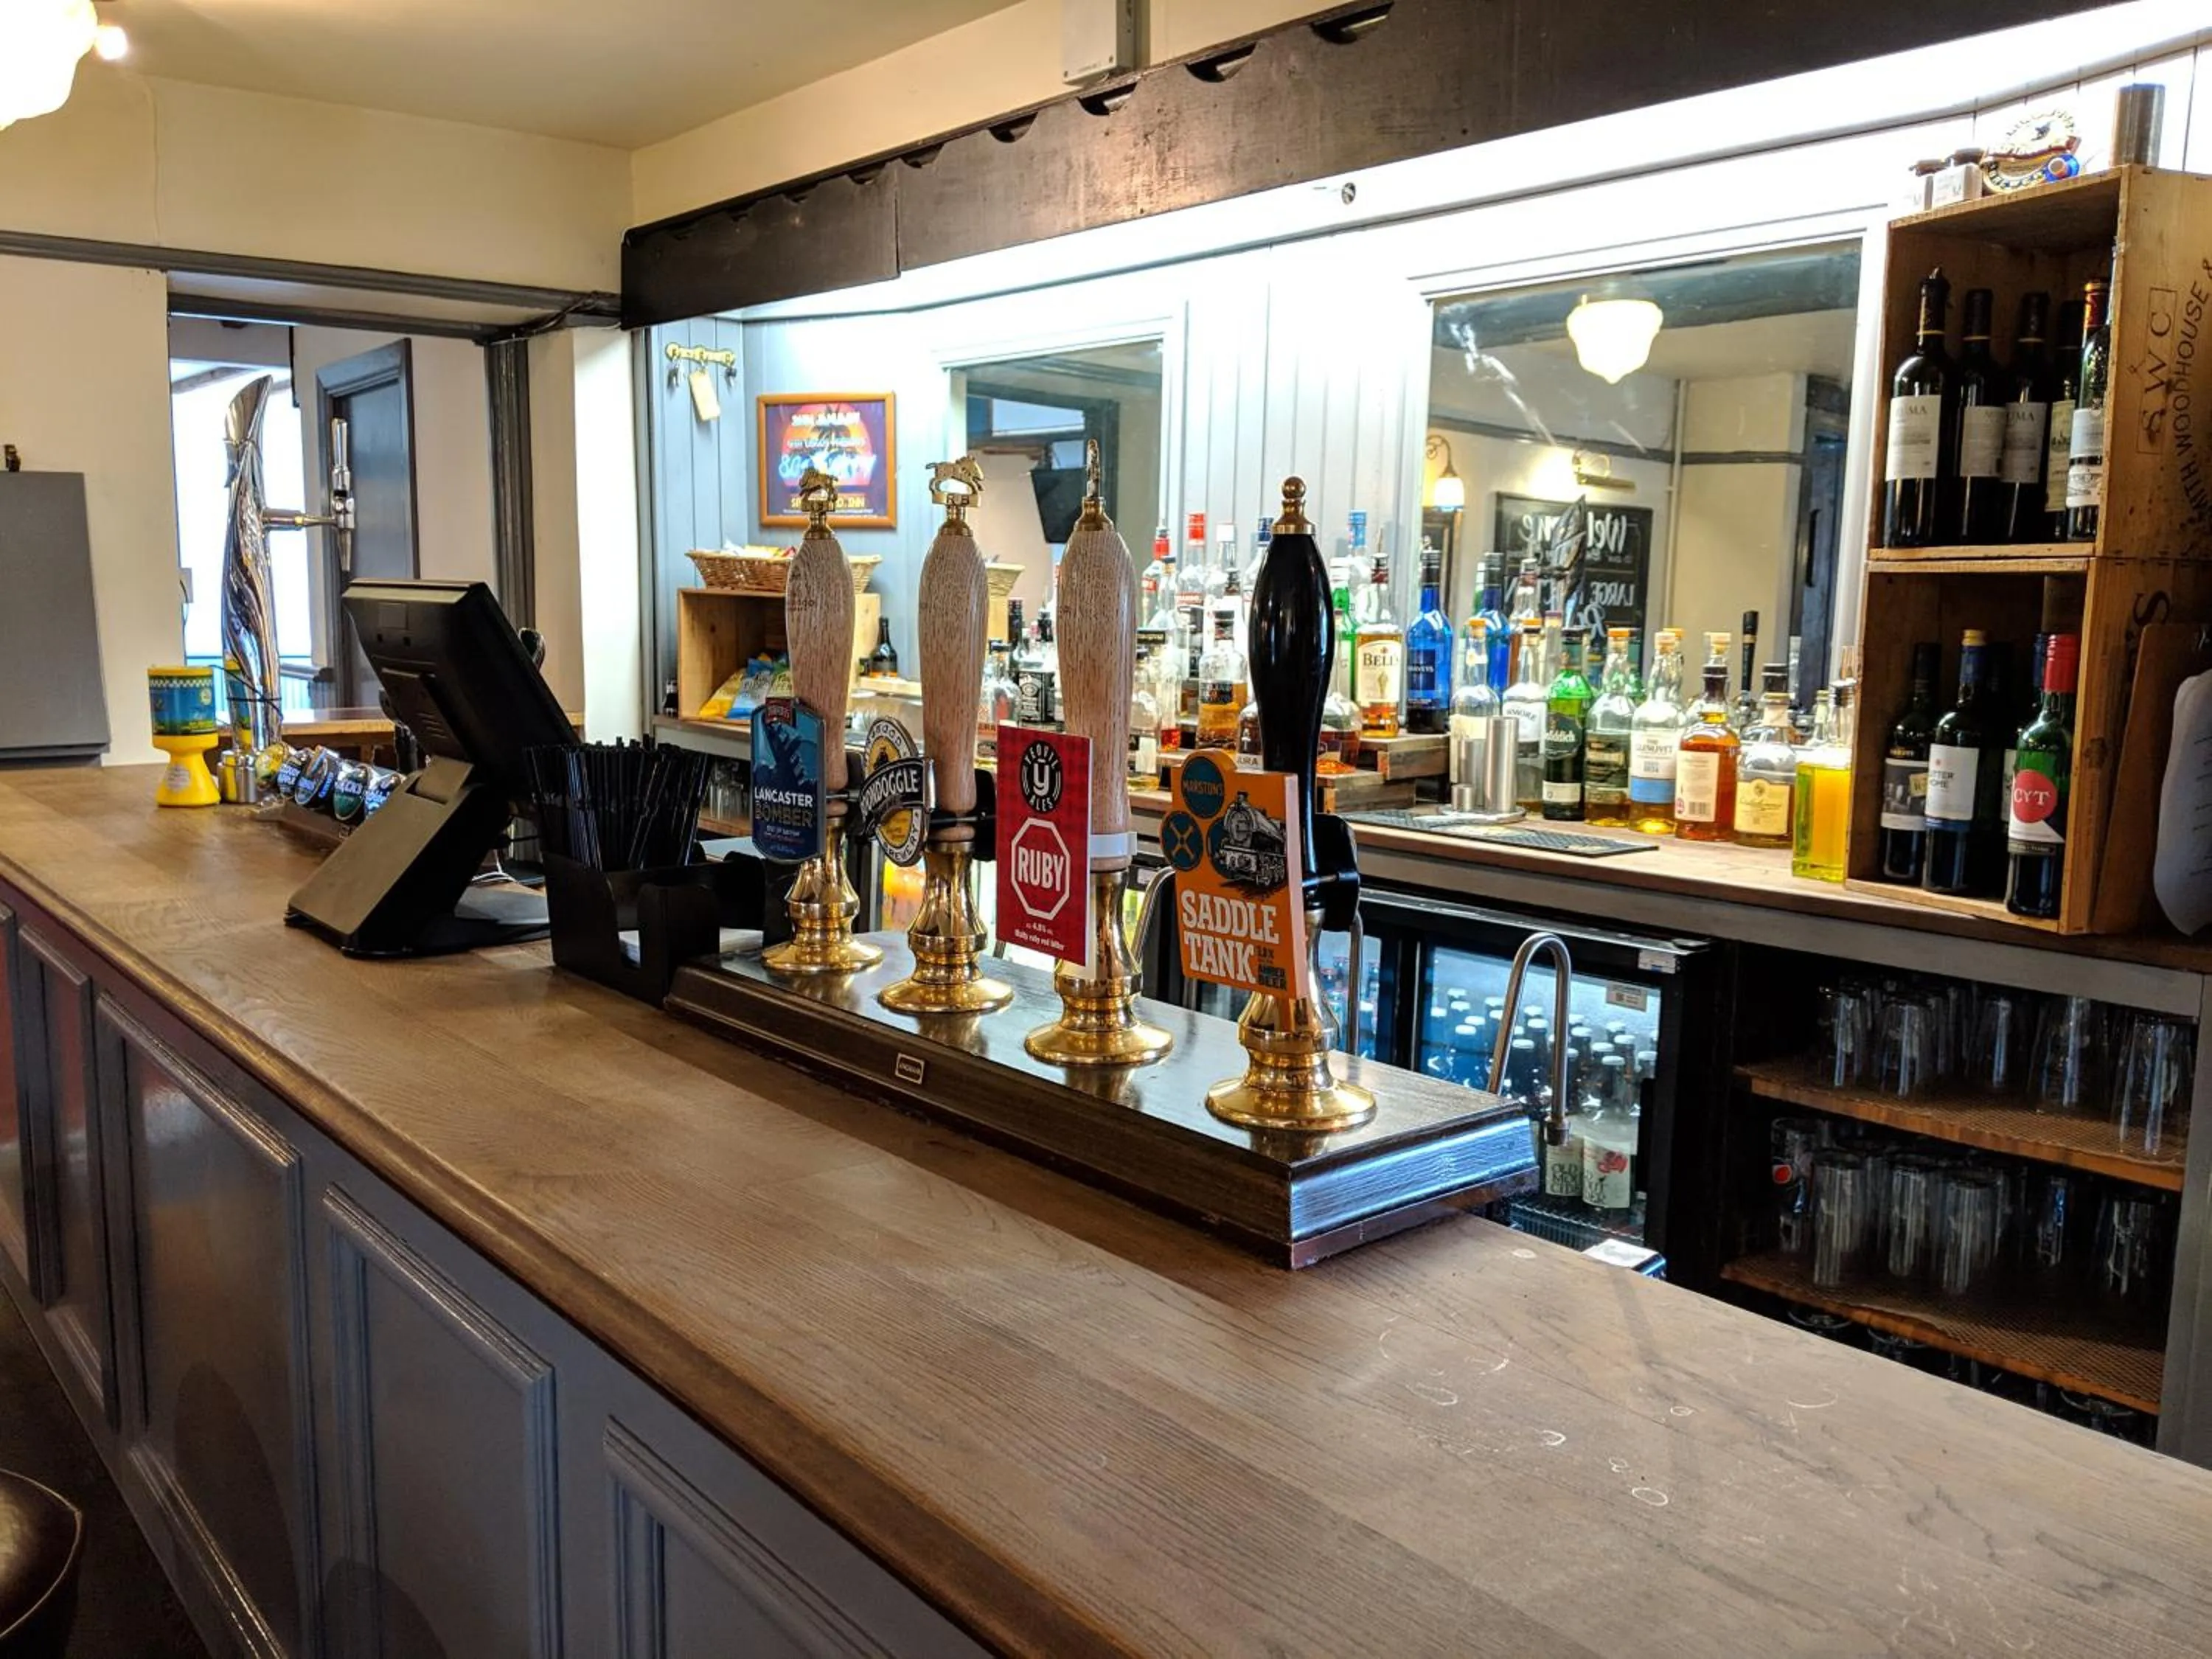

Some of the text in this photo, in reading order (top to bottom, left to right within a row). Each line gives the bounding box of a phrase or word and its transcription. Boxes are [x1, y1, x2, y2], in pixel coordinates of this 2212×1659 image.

[2172, 280, 2210, 456] WOODHOUSE
[1023, 742, 1059, 770] YEOVIL
[754, 786, 813, 808] LANCASTER
[754, 800, 813, 828] BOMBER
[1029, 794, 1054, 812] ALES
[1018, 846, 1064, 891] RUBY
[1180, 889, 1279, 945] SADDLE
[1184, 930, 1256, 984] TANK
